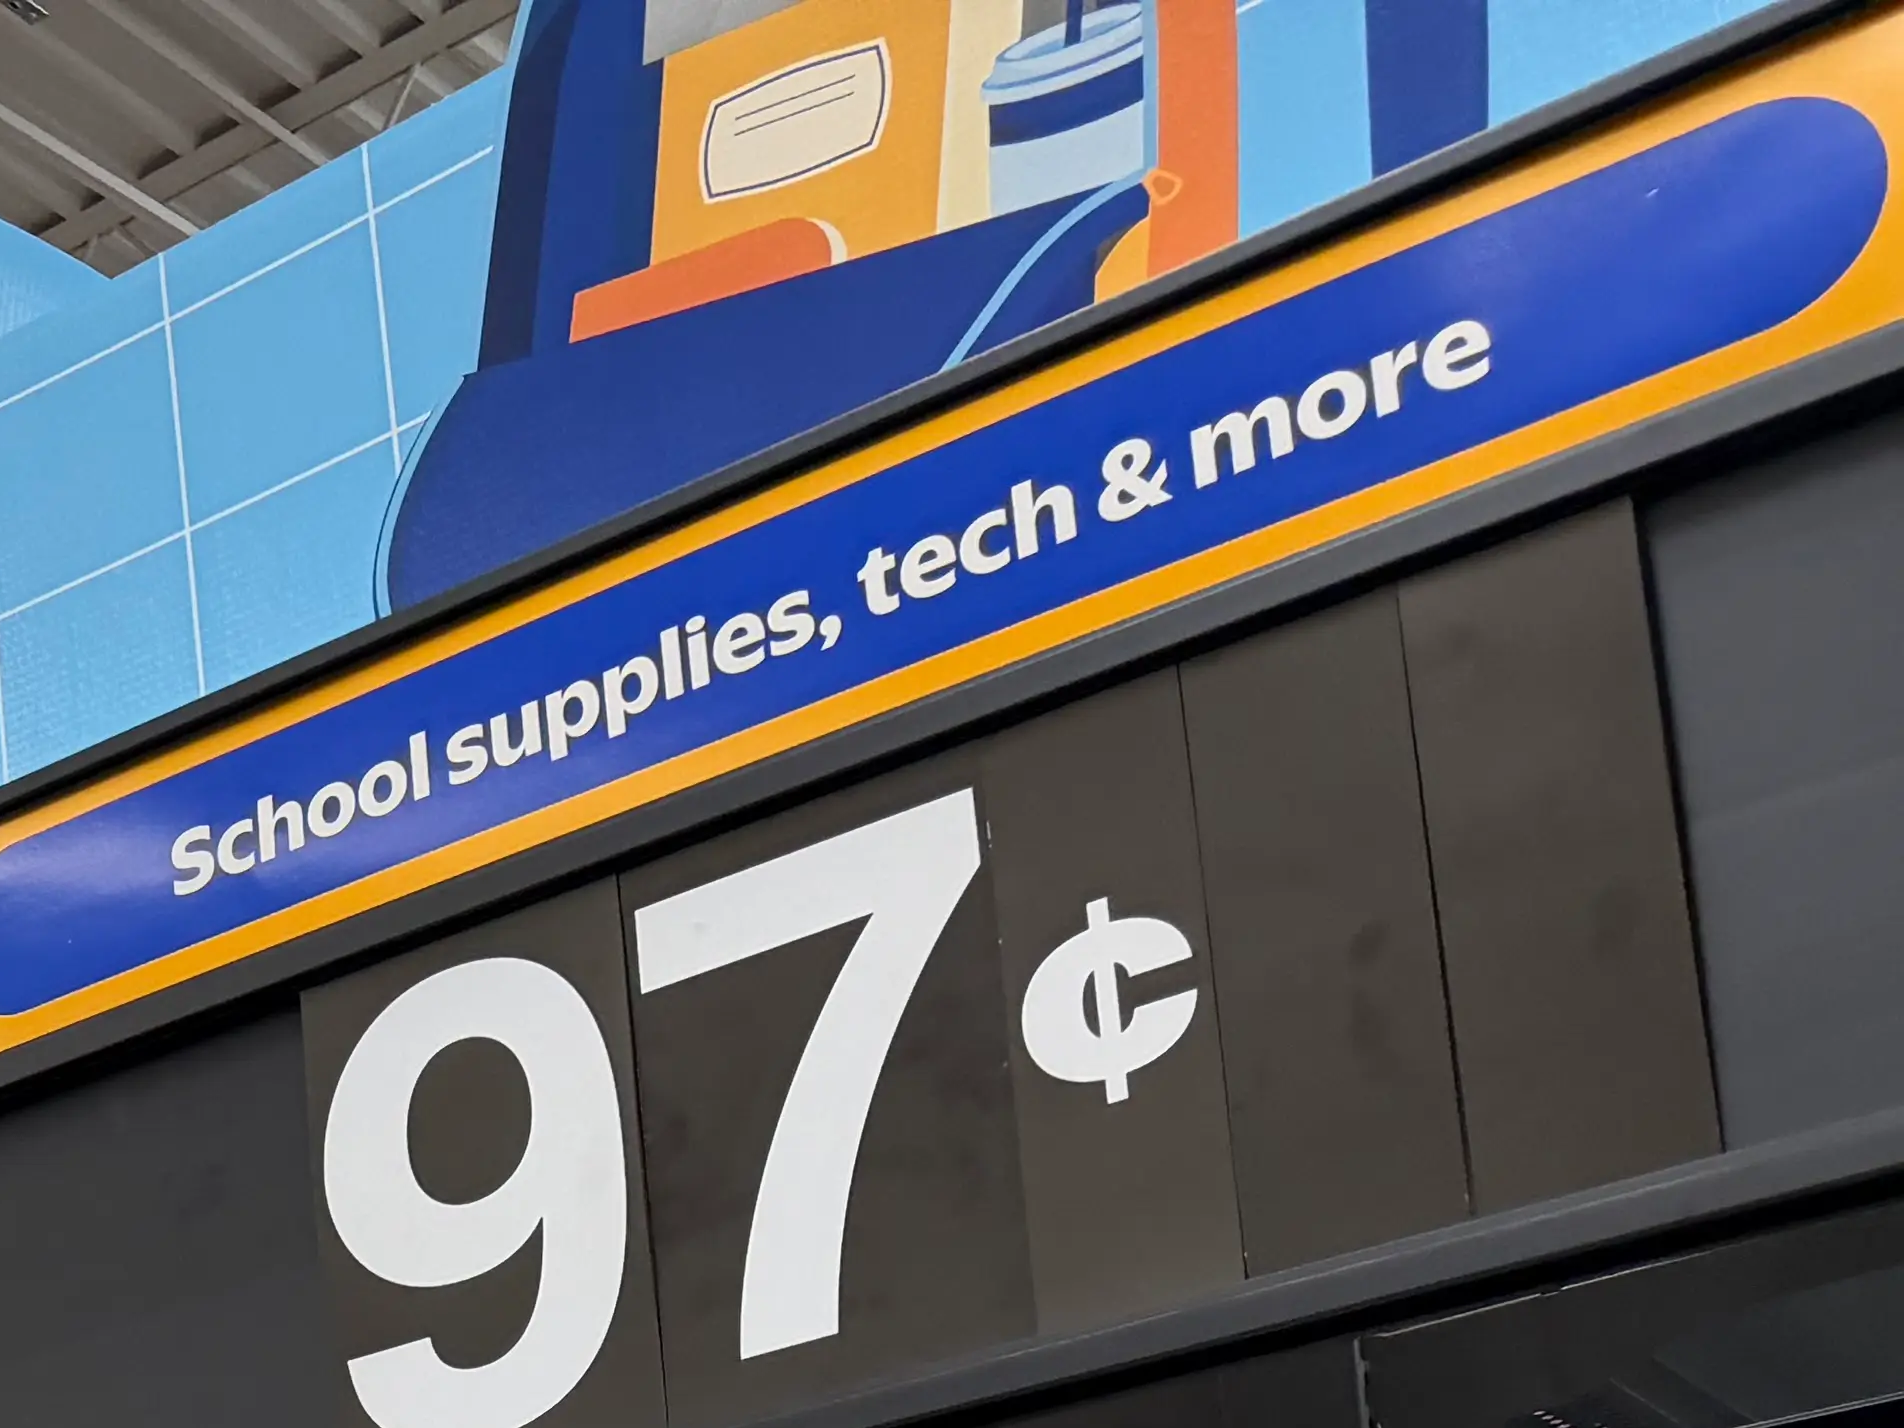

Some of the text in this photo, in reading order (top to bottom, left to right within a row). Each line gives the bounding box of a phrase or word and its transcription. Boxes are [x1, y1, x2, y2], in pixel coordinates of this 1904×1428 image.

[170, 318, 1492, 898] School supplies, tech & more
